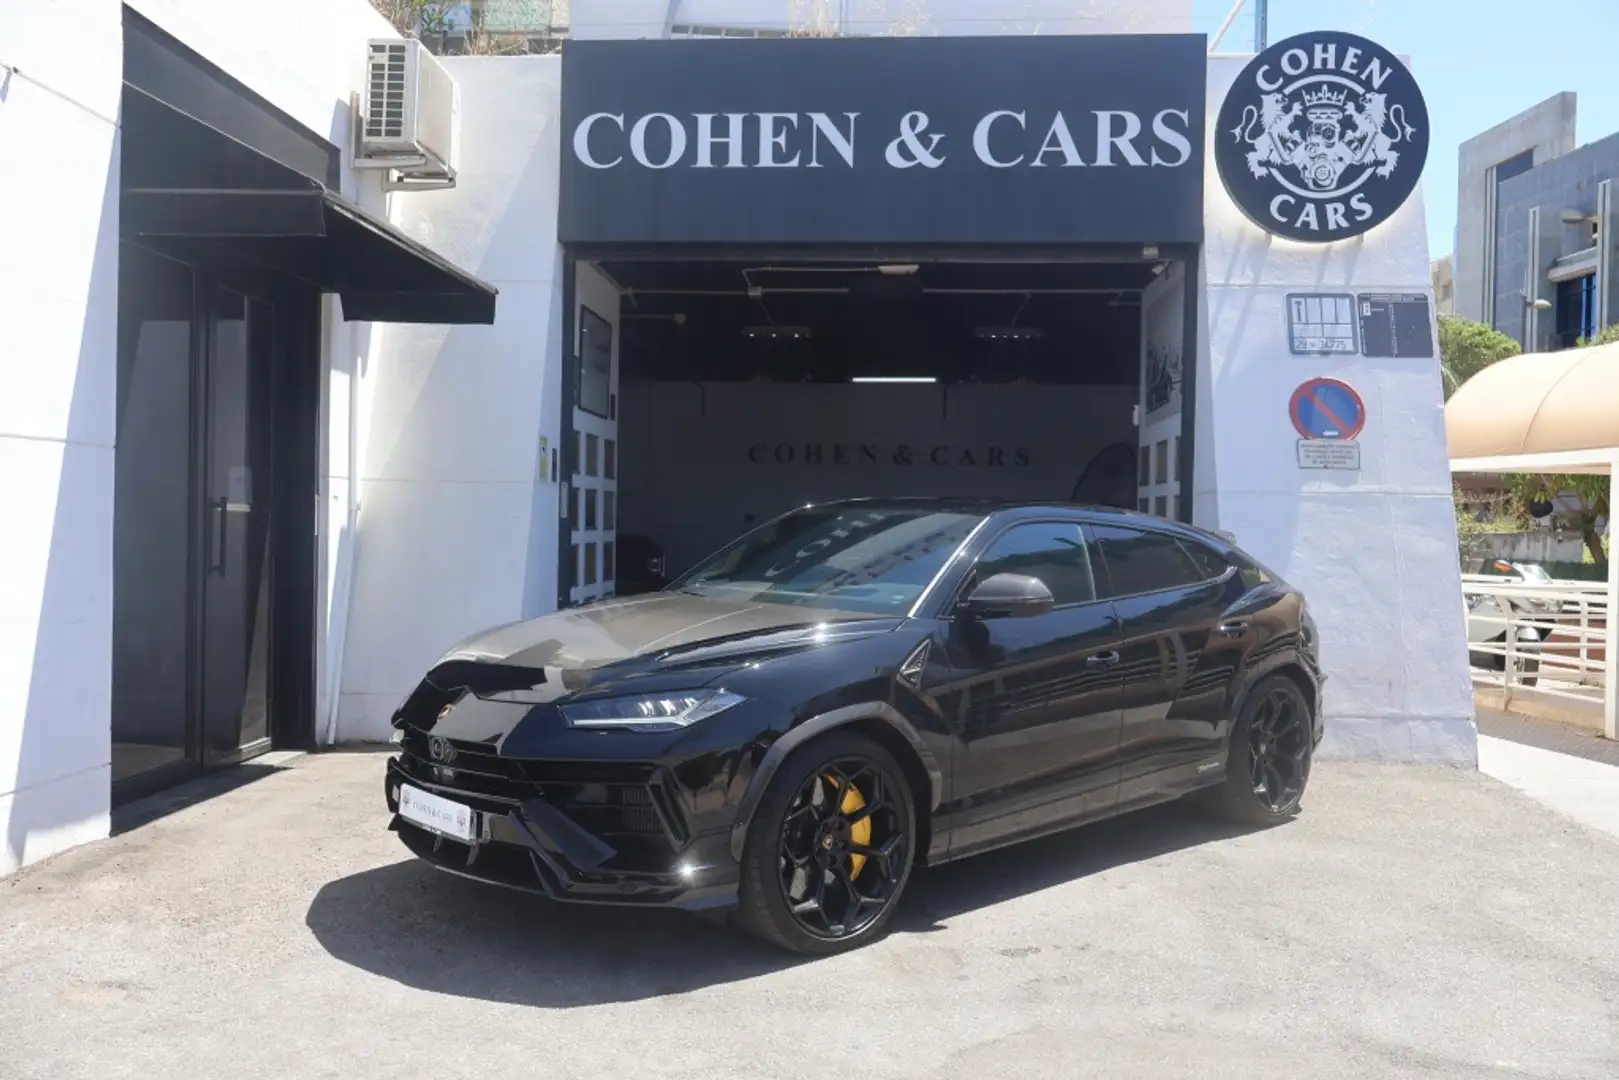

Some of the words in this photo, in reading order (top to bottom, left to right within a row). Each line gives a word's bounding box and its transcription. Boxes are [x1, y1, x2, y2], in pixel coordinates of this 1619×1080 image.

[1255, 43, 1393, 91] COHEN
[572, 111, 862, 169] COHEN
[884, 110, 947, 169] &
[972, 108, 1192, 169] CARS
[1269, 192, 1374, 231] CARS
[747, 442, 878, 466] COHEN
[891, 443, 915, 466] &
[929, 444, 1031, 468] CARS
